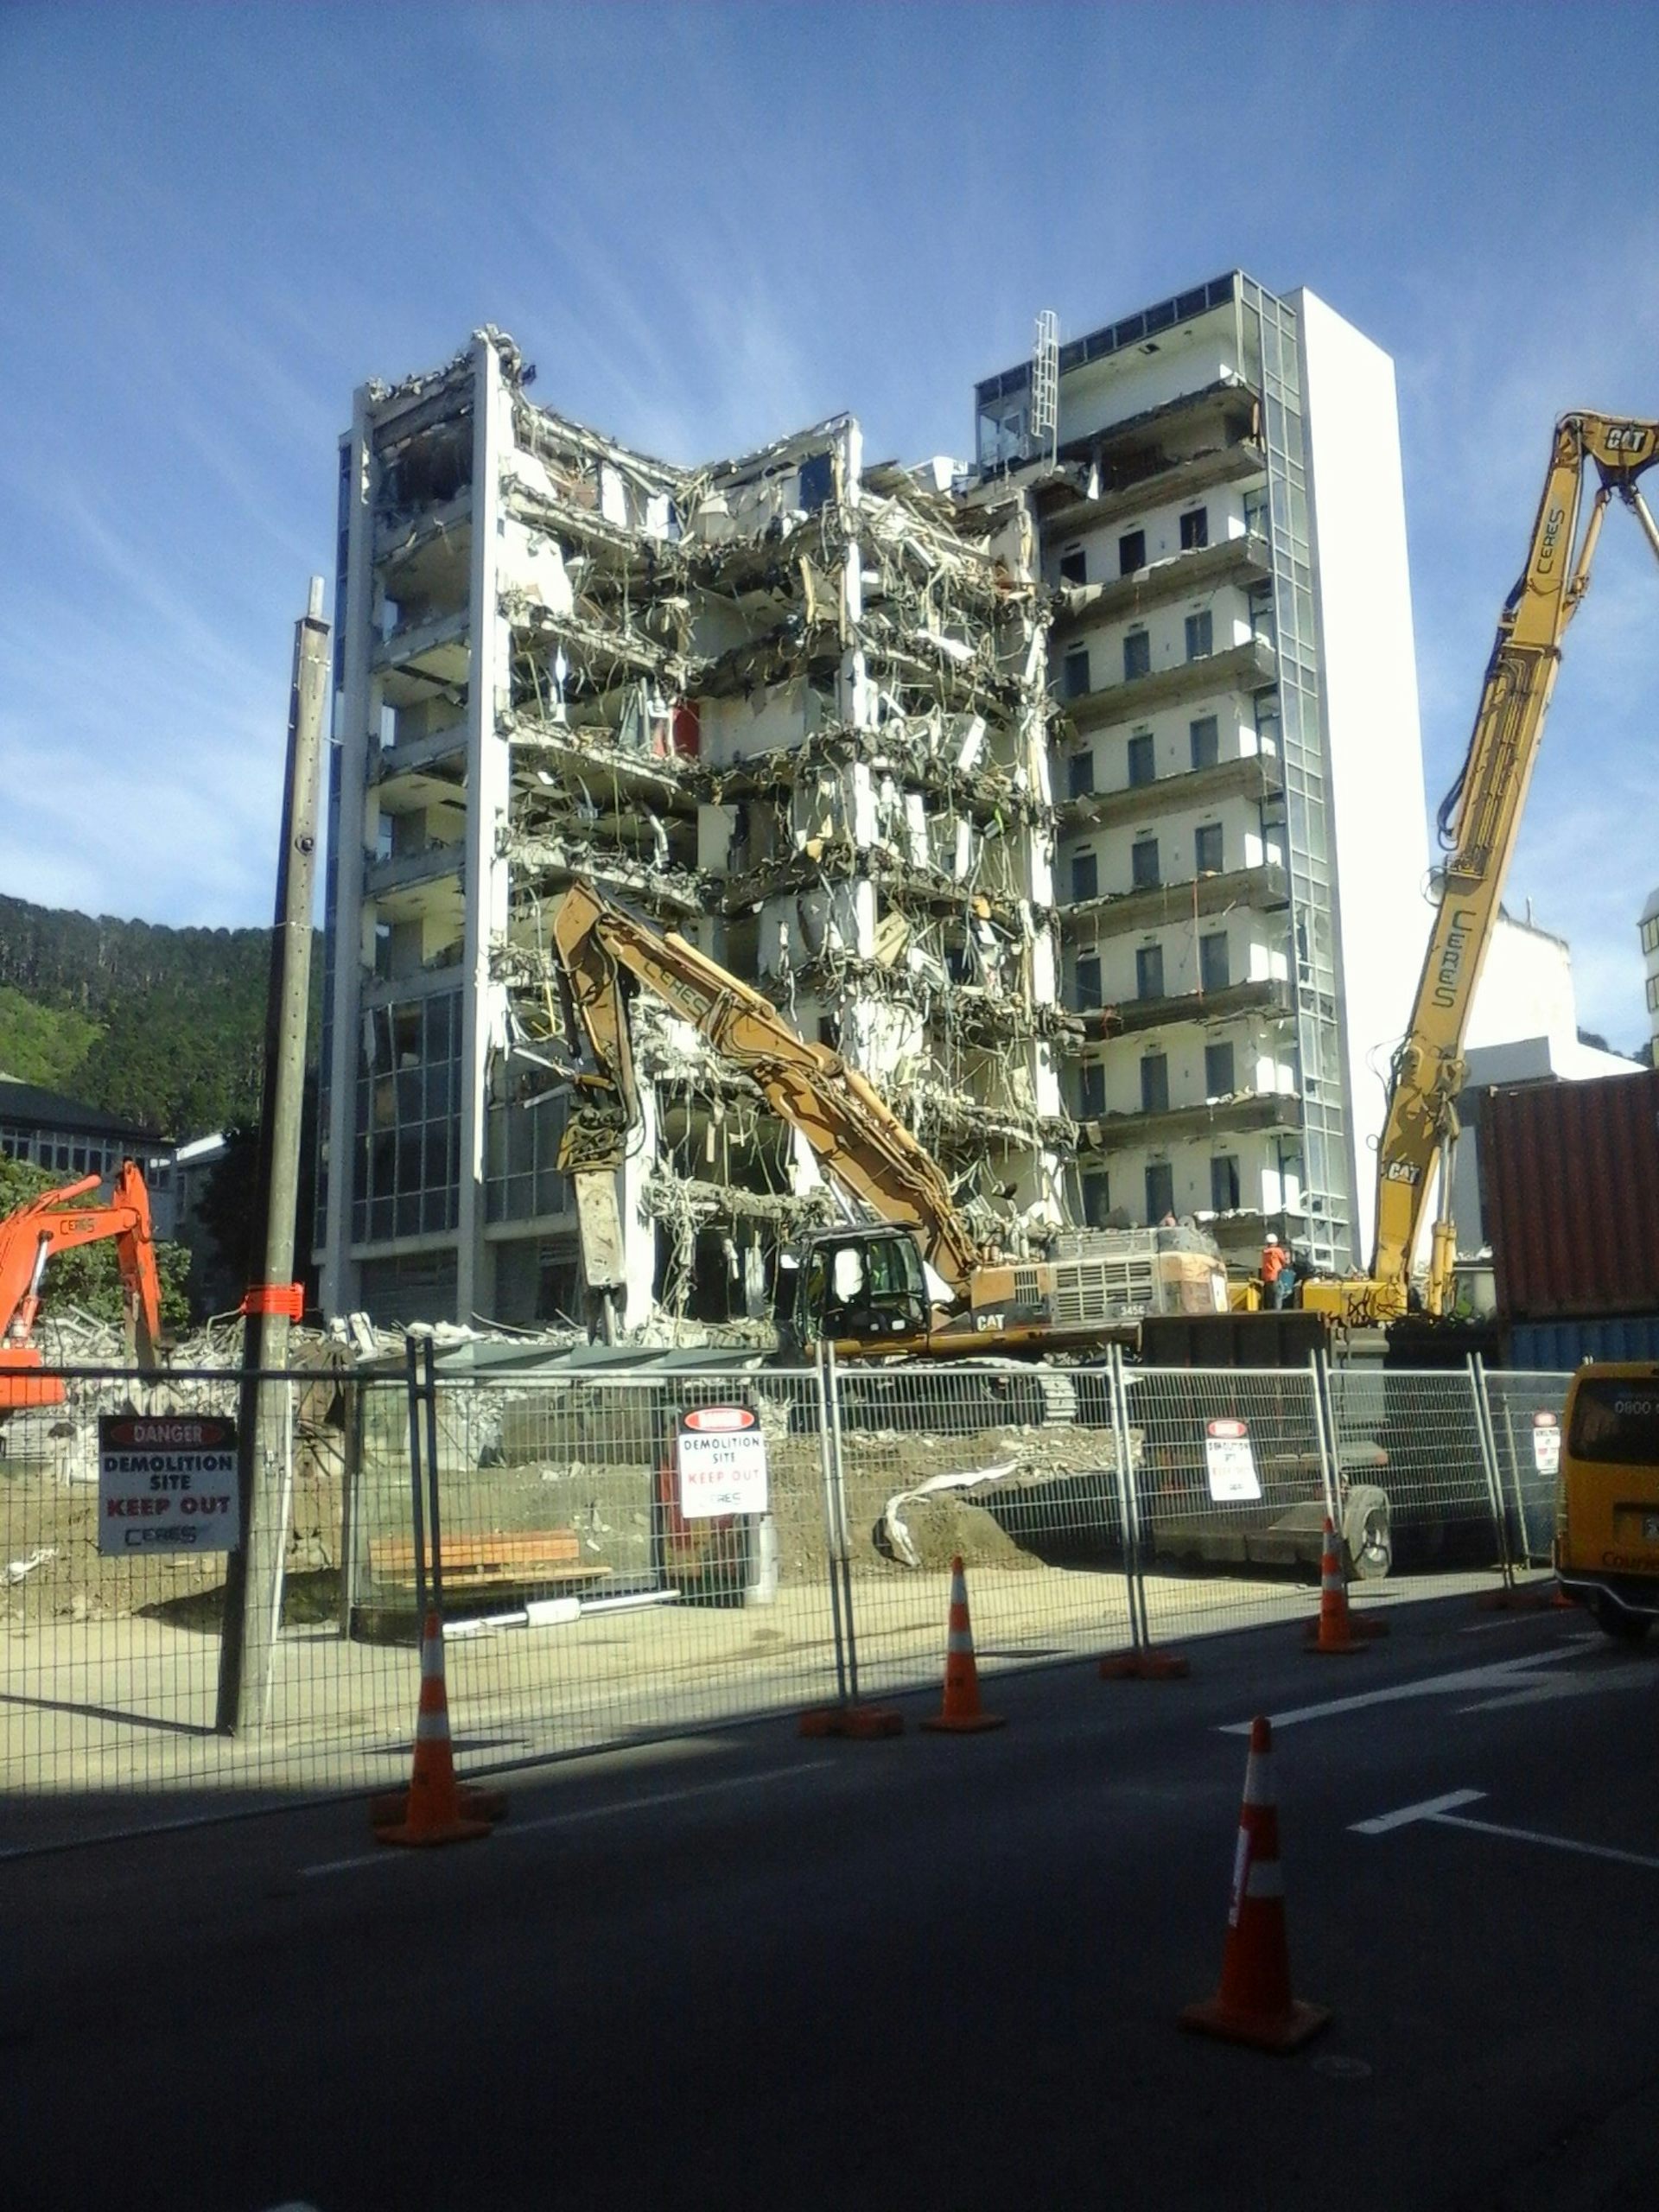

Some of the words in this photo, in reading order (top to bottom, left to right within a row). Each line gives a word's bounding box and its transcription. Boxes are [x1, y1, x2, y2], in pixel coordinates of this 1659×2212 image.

[1607, 429, 1645, 452] CAT
[1536, 509, 1566, 575] CERES
[1431, 910, 1478, 1008] CERES
[644, 962, 704, 1018] CERES
[1388, 1161, 1421, 1185] CAT
[976, 1313, 1006, 1332] CAT
[133, 1424, 204, 1443] DANGER
[683, 1436, 760, 1451] DEMOLITION
[104, 1454, 232, 1473] DEMOLITION
[712, 1452, 735, 1465] SITE
[149, 1474, 192, 1491] SITE
[688, 1471, 725, 1485] KEEP
[731, 1468, 760, 1481] OUT
[106, 1497, 171, 1517] KEEP
[179, 1496, 231, 1515] OUT
[124, 1525, 198, 1547] CERES
